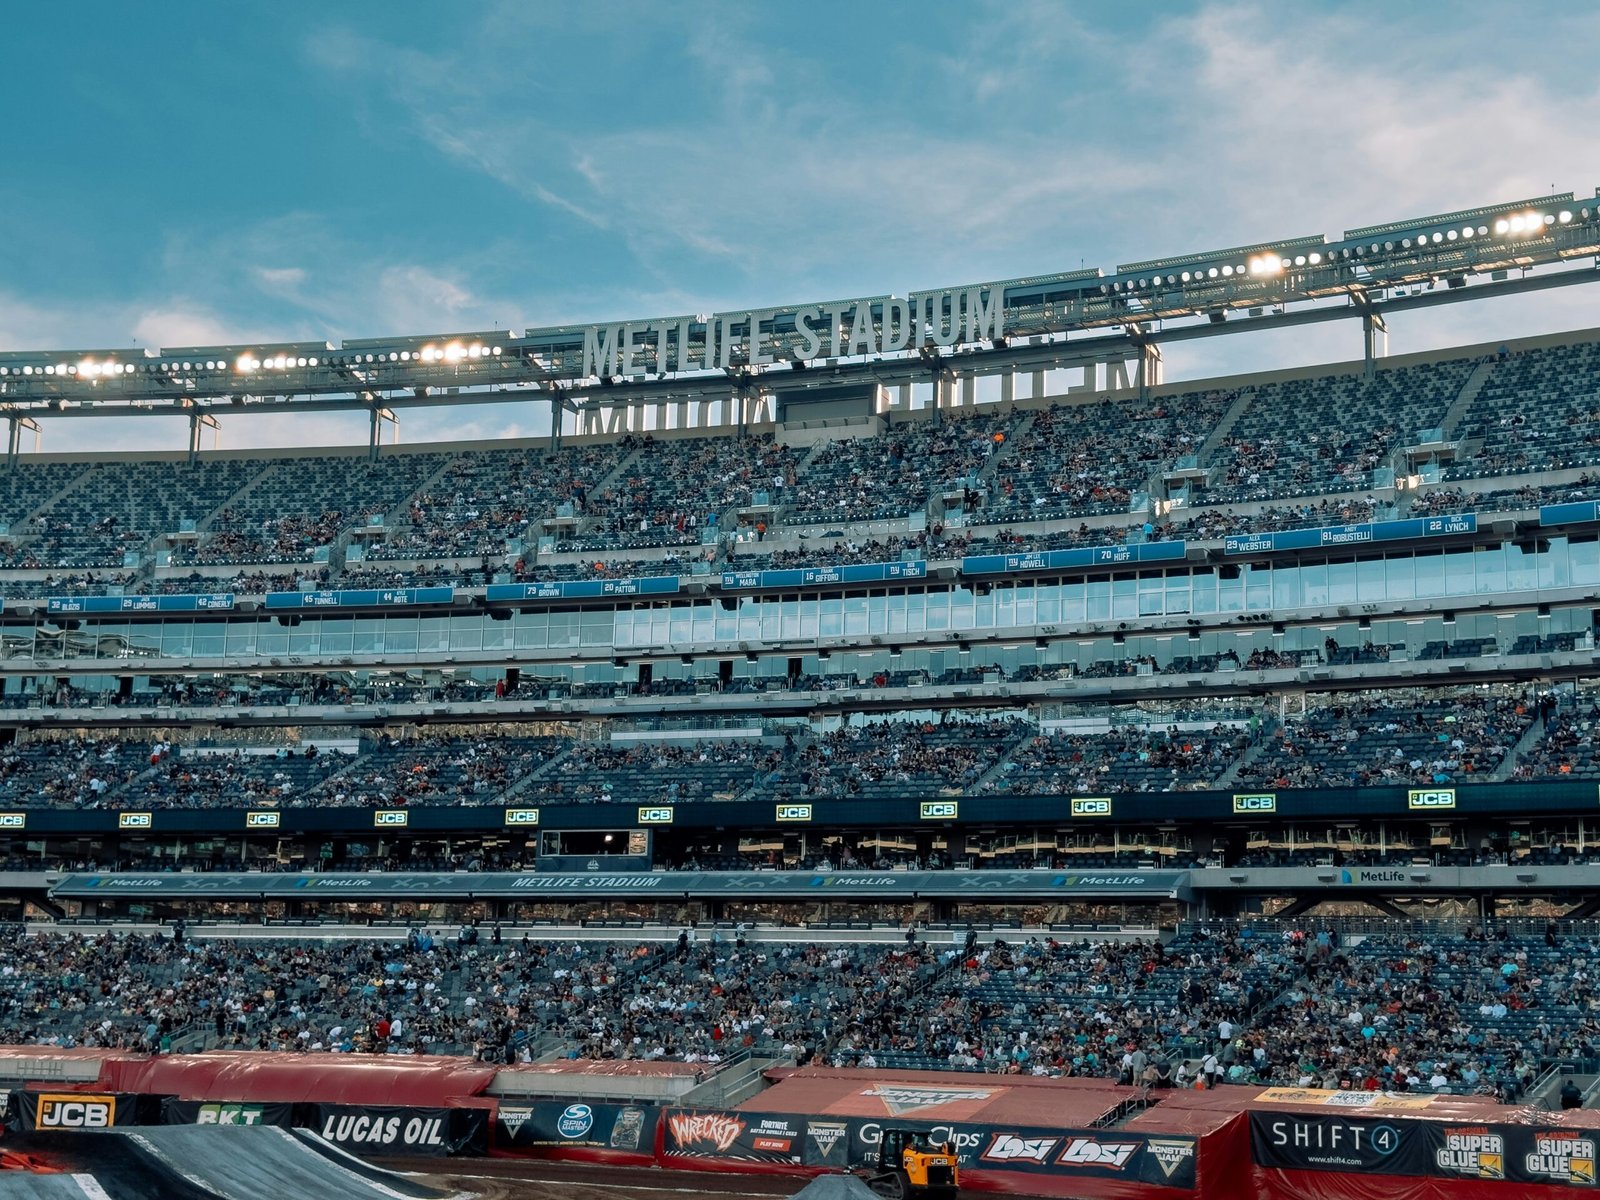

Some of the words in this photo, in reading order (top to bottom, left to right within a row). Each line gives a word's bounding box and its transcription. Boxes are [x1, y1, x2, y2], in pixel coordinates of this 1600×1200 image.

[582, 311, 775, 379] METLIFE
[793, 284, 1005, 360] STADIUM
[1430, 521, 1441, 530] 22
[1444, 521, 1469, 532] LYNCH
[1322, 532, 1332, 540] 81
[1333, 531, 1370, 542] ROBUSTELLI
[1227, 540, 1237, 549] 29
[1239, 540, 1271, 551] WEBSTER
[1101, 551, 1111, 559] 70
[1114, 552, 1130, 561] HUFF
[1020, 559, 1045, 568] HOWELL
[902, 567, 920, 576] TISCH
[739, 578, 757, 586] MARA
[806, 572, 814, 580] 16
[815, 573, 839, 582] GIFFORD
[605, 583, 613, 591] 20
[614, 585, 636, 593] PATTON
[198, 598, 207, 606] 42
[1236, 797, 1273, 809] JCB
[1412, 793, 1451, 805] JCB
[923, 805, 955, 816] JCB
[1074, 801, 1108, 813] JCB
[508, 812, 536, 822] JCB
[641, 810, 670, 821] JCB
[778, 808, 809, 818] JCB
[122, 815, 149, 826] JCB
[249, 815, 277, 825] JCB
[377, 814, 405, 824] JCB
[836, 877, 896, 885] MetLife
[1079, 876, 1145, 885] MetLife
[1361, 871, 1404, 881] MetLife
[511, 877, 585, 887] METLIFE
[585, 877, 662, 887] STADIUM
[860, 1089, 991, 1100] MONSTER
[42, 1103, 109, 1127] JCB
[498, 1112, 531, 1120] MONSTER
[562, 1119, 588, 1127] SPIN
[761, 1120, 788, 1130] FORTNITE
[322, 1115, 401, 1143] LUCAS
[673, 1113, 741, 1151] WRECKED
[807, 1128, 845, 1136] MONSTER
[817, 1135, 838, 1143] JAM
[928, 1126, 981, 1153] Clips
[1272, 1122, 1364, 1150] SHIFT
[1378, 1131, 1389, 1149] 4
[1449, 1135, 1502, 1152] SUPER
[1540, 1139, 1593, 1158] SUPER
[1147, 1146, 1193, 1157] MONSTER
[931, 1158, 949, 1166] JCB
[1160, 1154, 1182, 1162] JAM
[1308, 1155, 1362, 1165] www.shift4.com
[1440, 1151, 1478, 1168] GLUE
[1530, 1155, 1569, 1173] GLUE
